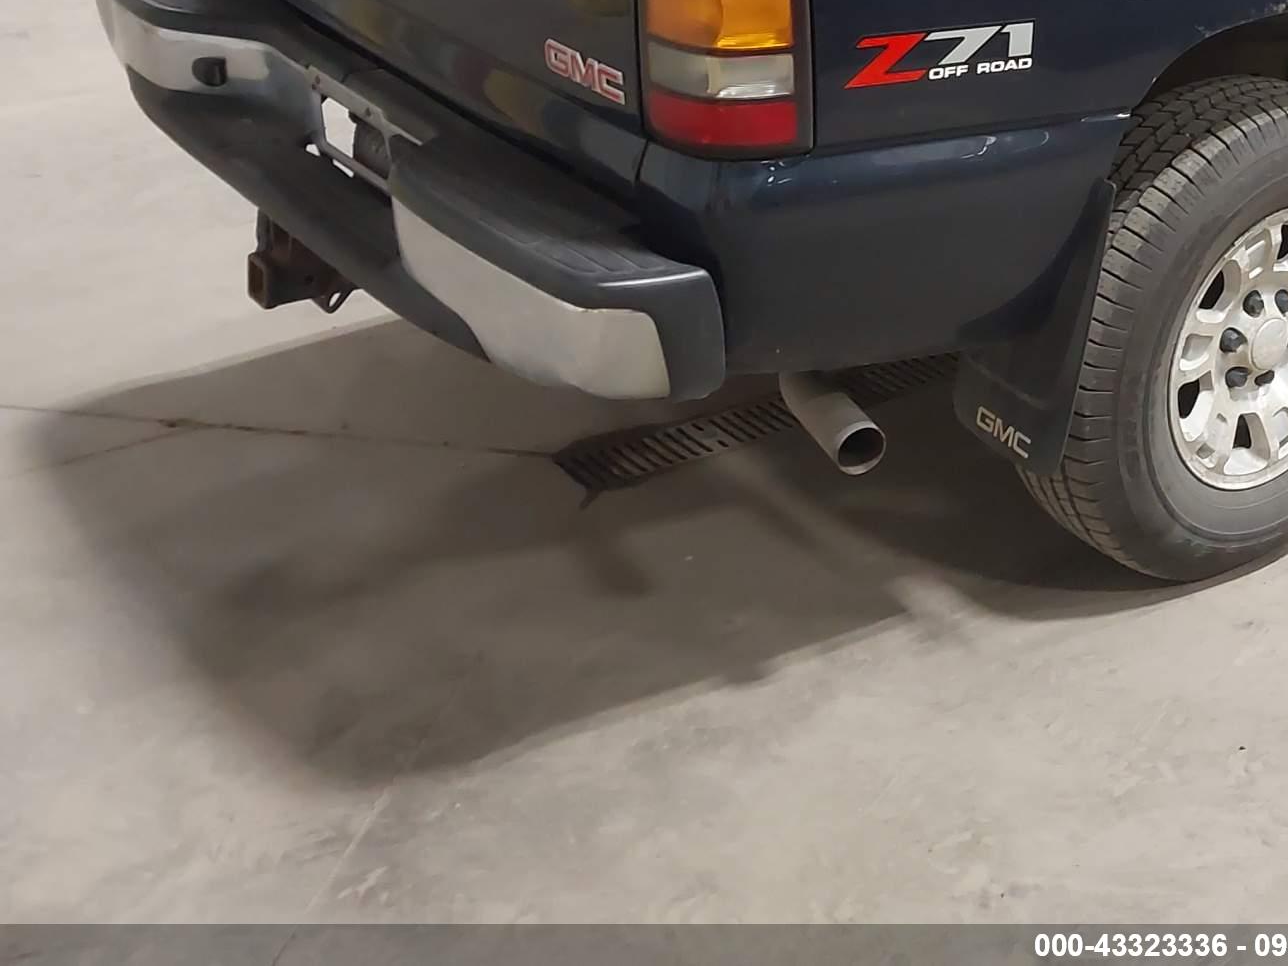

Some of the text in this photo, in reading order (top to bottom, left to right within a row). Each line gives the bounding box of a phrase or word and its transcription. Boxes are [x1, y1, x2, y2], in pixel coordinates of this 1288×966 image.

[544, 38, 626, 105] GMC
[843, 20, 1035, 90] Z71
[928, 57, 1033, 80] OFF ROAD
[976, 406, 1032, 459] GMC
